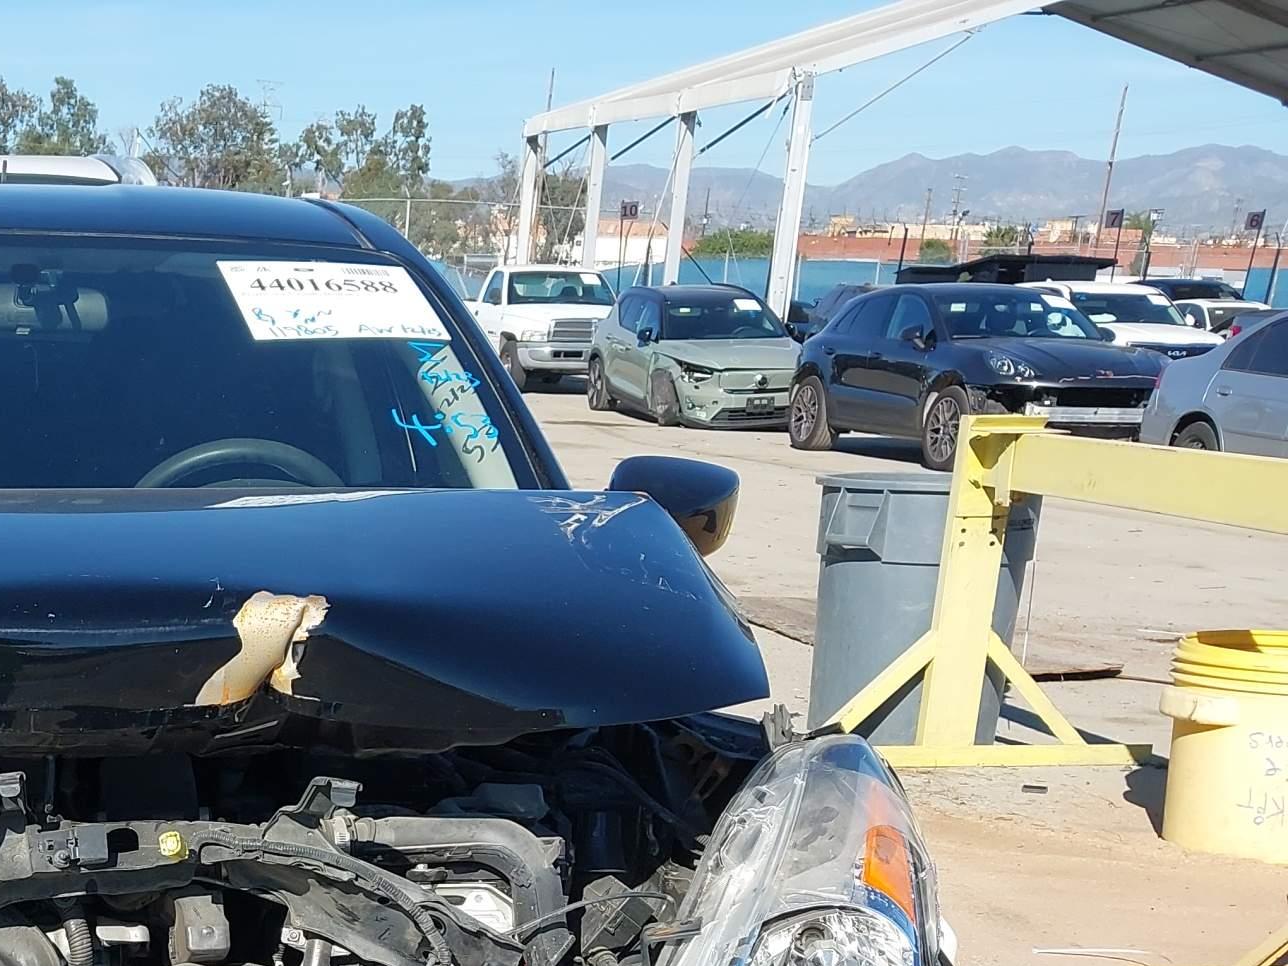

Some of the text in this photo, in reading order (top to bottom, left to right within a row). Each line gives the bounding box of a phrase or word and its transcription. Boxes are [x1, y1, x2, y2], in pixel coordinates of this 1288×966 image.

[622, 204, 638, 217] 10
[1109, 211, 1120, 226] 7
[1249, 213, 1261, 228] 6
[249, 277, 399, 294] 44016588
